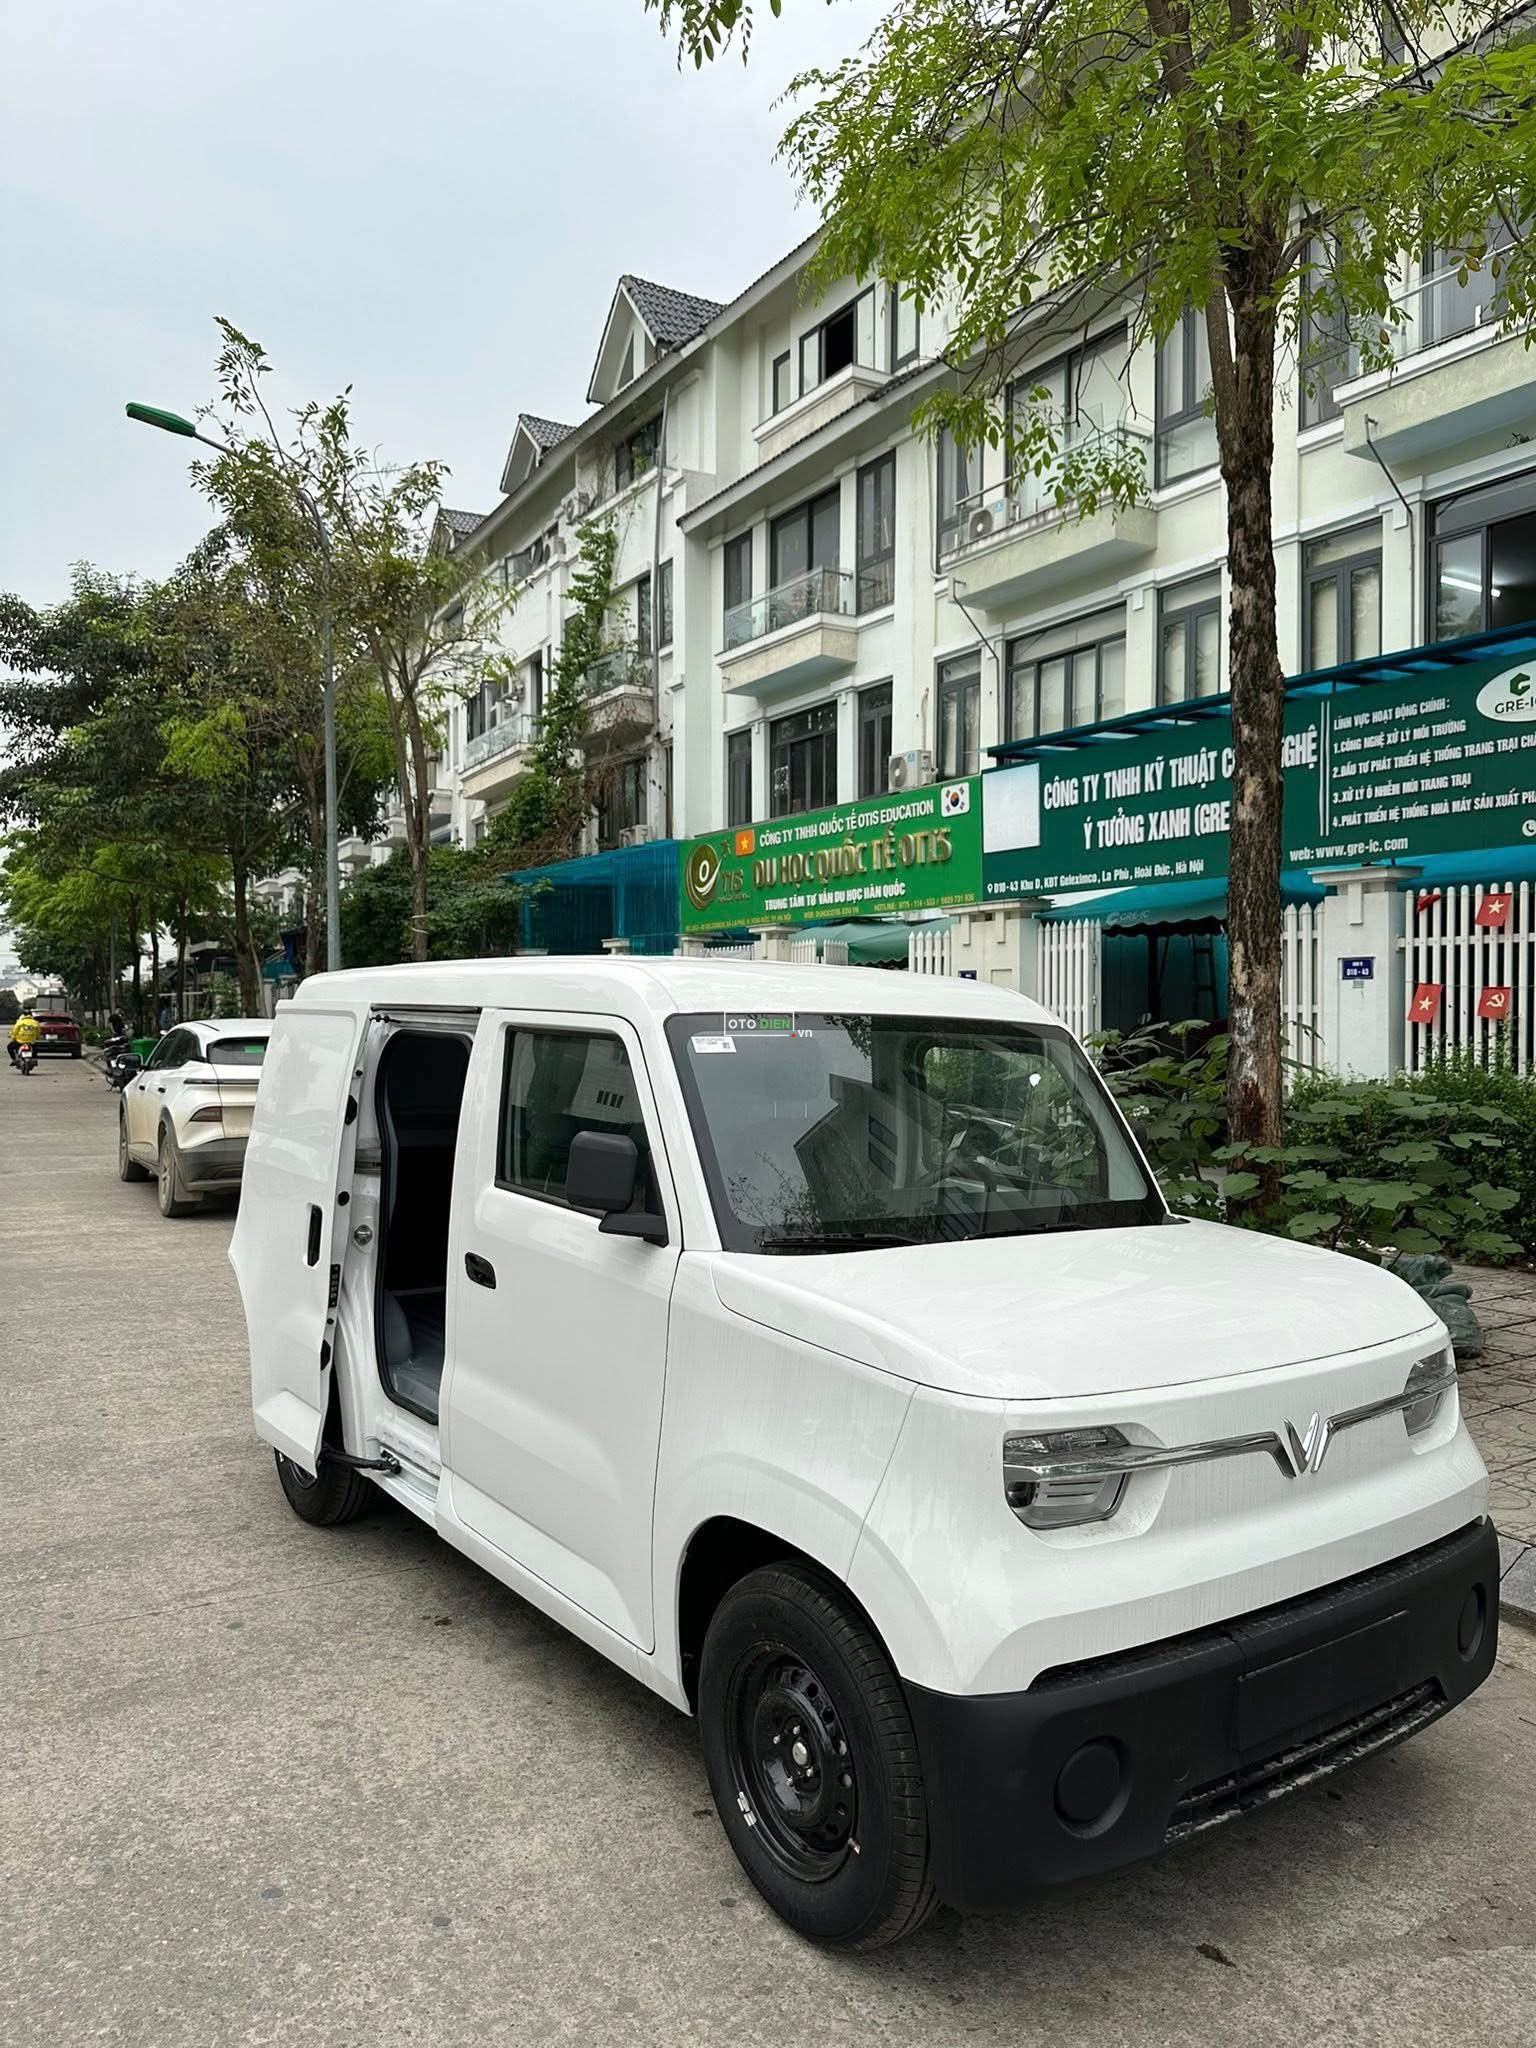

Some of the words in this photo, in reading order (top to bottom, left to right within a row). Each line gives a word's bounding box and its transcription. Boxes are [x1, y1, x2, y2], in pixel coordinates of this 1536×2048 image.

[1333, 715, 1352, 731] LĨNH
[1353, 712, 1371, 728] VỰC
[1372, 708, 1393, 724] HOẠT
[1395, 703, 1417, 720] ĐỘNG
[1495, 696, 1536, 714] GRE-I
[1363, 731, 1385, 749] NGHỆ
[1386, 728, 1399, 745] XỬ
[1400, 727, 1411, 743] LÝ
[1413, 724, 1430, 740] MÔI
[1431, 719, 1467, 737] TRƯỜNG
[1358, 760, 1370, 775] TƯ
[1370, 756, 1392, 773] PHÁT
[1394, 749, 1418, 769] TRIỂN
[1420, 748, 1431, 767] HỆ
[1434, 744, 1462, 762] THỐNG
[1464, 741, 1495, 758] TRANG
[1497, 737, 1518, 753] TRẠI
[1043, 776, 1079, 810] CÔNG
[1082, 774, 1100, 803] TY
[1104, 766, 1140, 800] TNHH
[1144, 756, 1165, 793] KỸ
[1169, 747, 1218, 789] THUẬT
[1355, 785, 1365, 801] LÝ
[1366, 784, 1373, 799] Ô
[1374, 779, 1400, 798] NHIỄM
[1402, 778, 1419, 795] MÙI
[1420, 776, 1449, 791] TRANG
[1450, 772, 1472, 789] TRẠI
[1364, 805, 1388, 824] TRIỂN
[1389, 805, 1400, 823] HỆ
[1401, 801, 1429, 819] THỐNG
[1430, 799, 1449, 816] NHÀ
[1452, 796, 1472, 813] MÁY
[1473, 792, 1494, 810] SẢN
[1495, 788, 1520, 808] XUẤT
[759, 829, 781, 848] CÔNG
[782, 829, 793, 843] TY
[795, 824, 818, 841] TNHH
[819, 812, 844, 836] QUỐC
[845, 808, 858, 830] TẾ
[858, 810, 880, 828] OTIS
[880, 799, 934, 823] EDUCATION
[1083, 816, 1094, 850] Ý
[1097, 807, 1145, 848] TƯỞNG
[1148, 807, 1191, 842] XANH
[1194, 801, 1231, 836] (GRE
[753, 856, 777, 888] DU
[781, 852, 814, 888] HỌC
[816, 832, 868, 884] QUỐC
[872, 824, 896, 870] TẾ
[900, 827, 953, 866] OTIS
[1289, 846, 1315, 861] web:
[1020, 879, 1034, 891] Khu
[1035, 878, 1044, 890] D,
[1101, 870, 1112, 882] La
[1114, 867, 1133, 881] Phù,
[1134, 864, 1153, 879] Hoài
[1175, 860, 1187, 875] Hà
[1189, 858, 1205, 875] Nội
[765, 897, 788, 911] TRUNG
[789, 894, 805, 908] TÂM
[807, 892, 818, 906] TƯ
[819, 887, 834, 905] VẤN
[835, 890, 846, 903] DU
[846, 888, 863, 904] HỌC
[864, 884, 882, 900] HÀN
[883, 878, 906, 898] QUỐC
